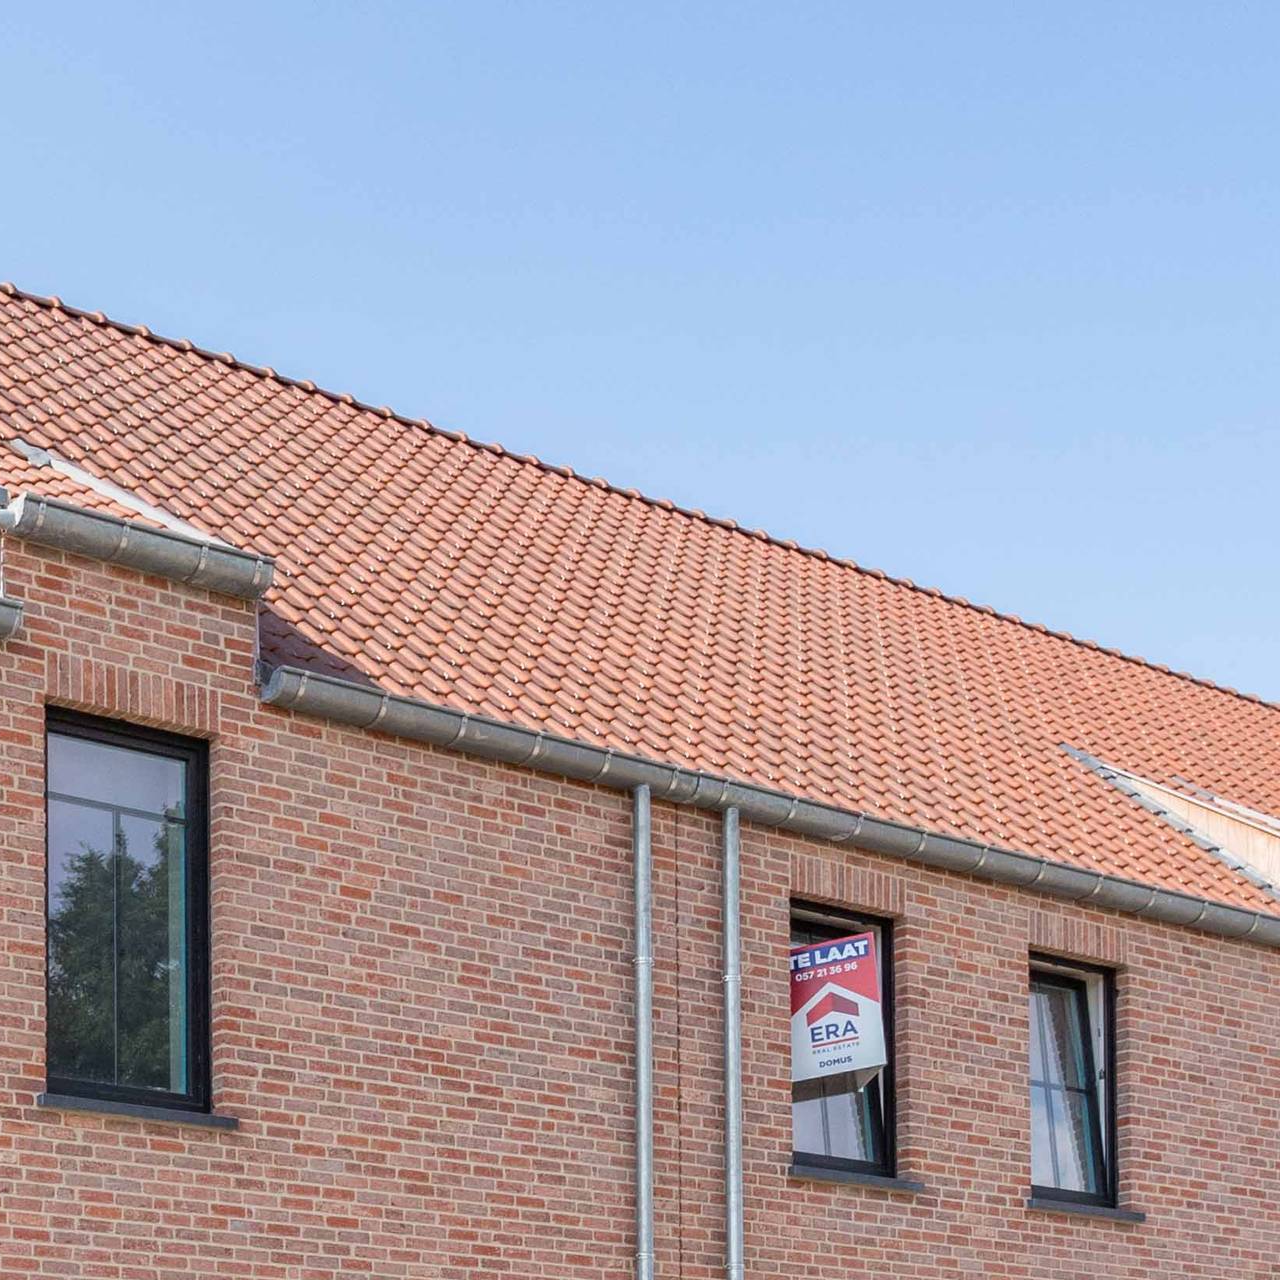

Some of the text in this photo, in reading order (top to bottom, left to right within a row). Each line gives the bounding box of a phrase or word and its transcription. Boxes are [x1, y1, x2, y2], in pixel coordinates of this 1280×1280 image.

[814, 940, 868, 965] LAAT
[795, 961, 858, 982] 057 21 36 96
[810, 1020, 858, 1042] ERA
[819, 1055, 853, 1068] DOMUS
